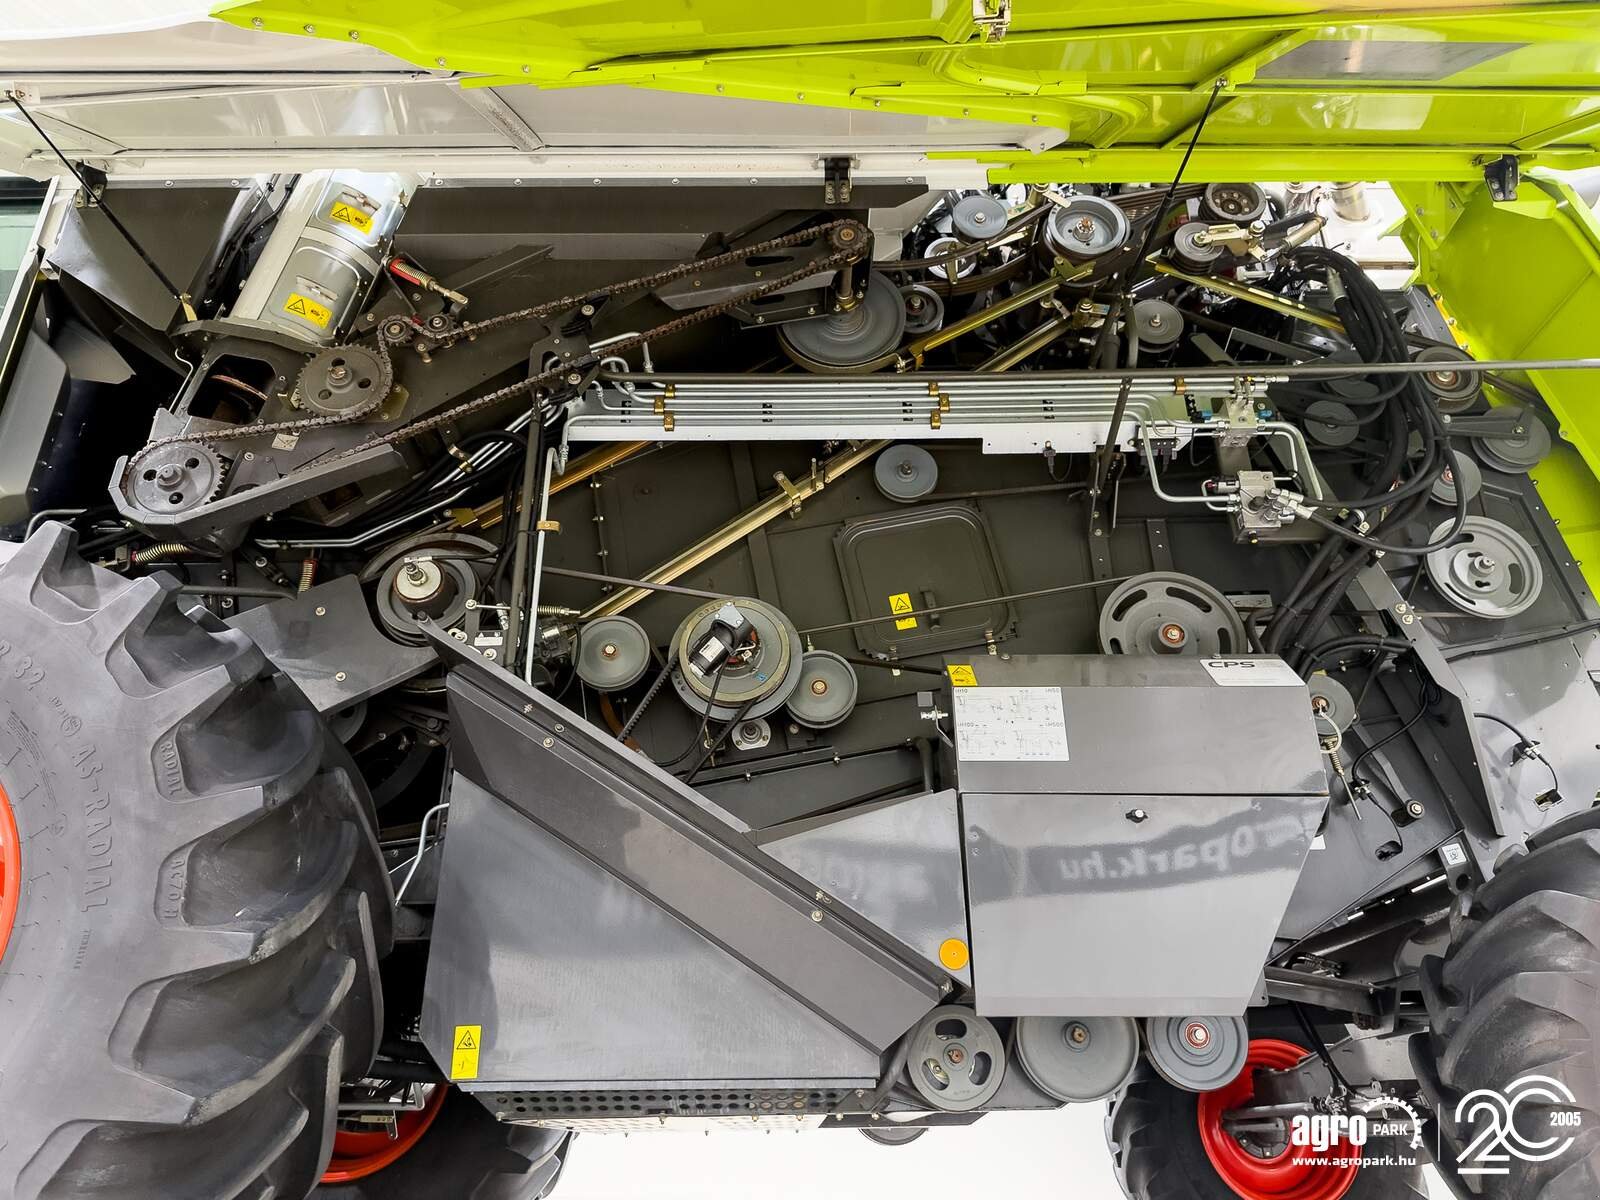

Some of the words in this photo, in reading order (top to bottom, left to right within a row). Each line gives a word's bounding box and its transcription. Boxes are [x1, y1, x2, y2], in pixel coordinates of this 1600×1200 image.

[1207, 661, 1256, 669] CPS
[160, 740, 182, 795] RADIAL
[72, 744, 113, 912] AS-RADIAL
